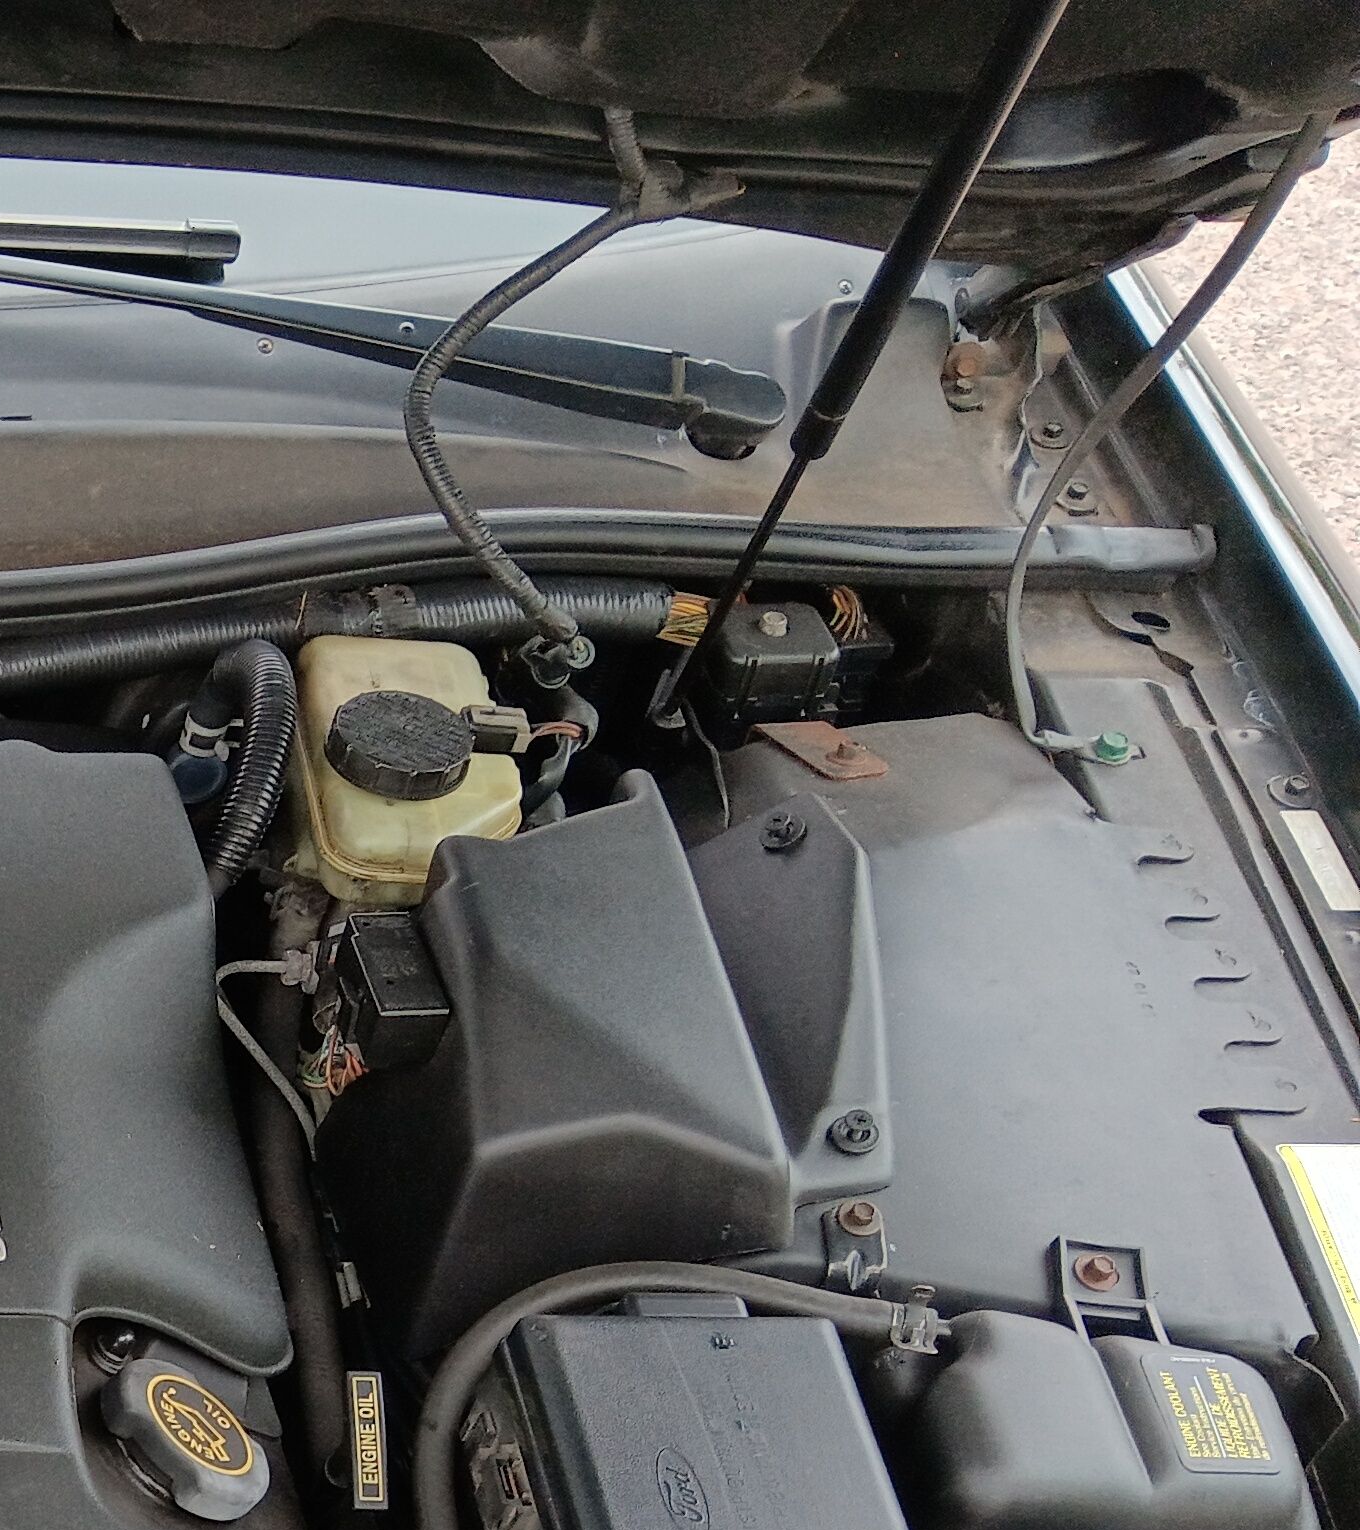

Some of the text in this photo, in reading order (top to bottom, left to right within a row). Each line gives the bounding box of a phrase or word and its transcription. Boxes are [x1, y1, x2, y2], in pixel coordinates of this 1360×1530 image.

[358, 1392, 379, 1485] ENGINE OIL
[1160, 1371, 1201, 1457] ENGINE COOLANT
[663, 1466, 704, 1523] Ford
